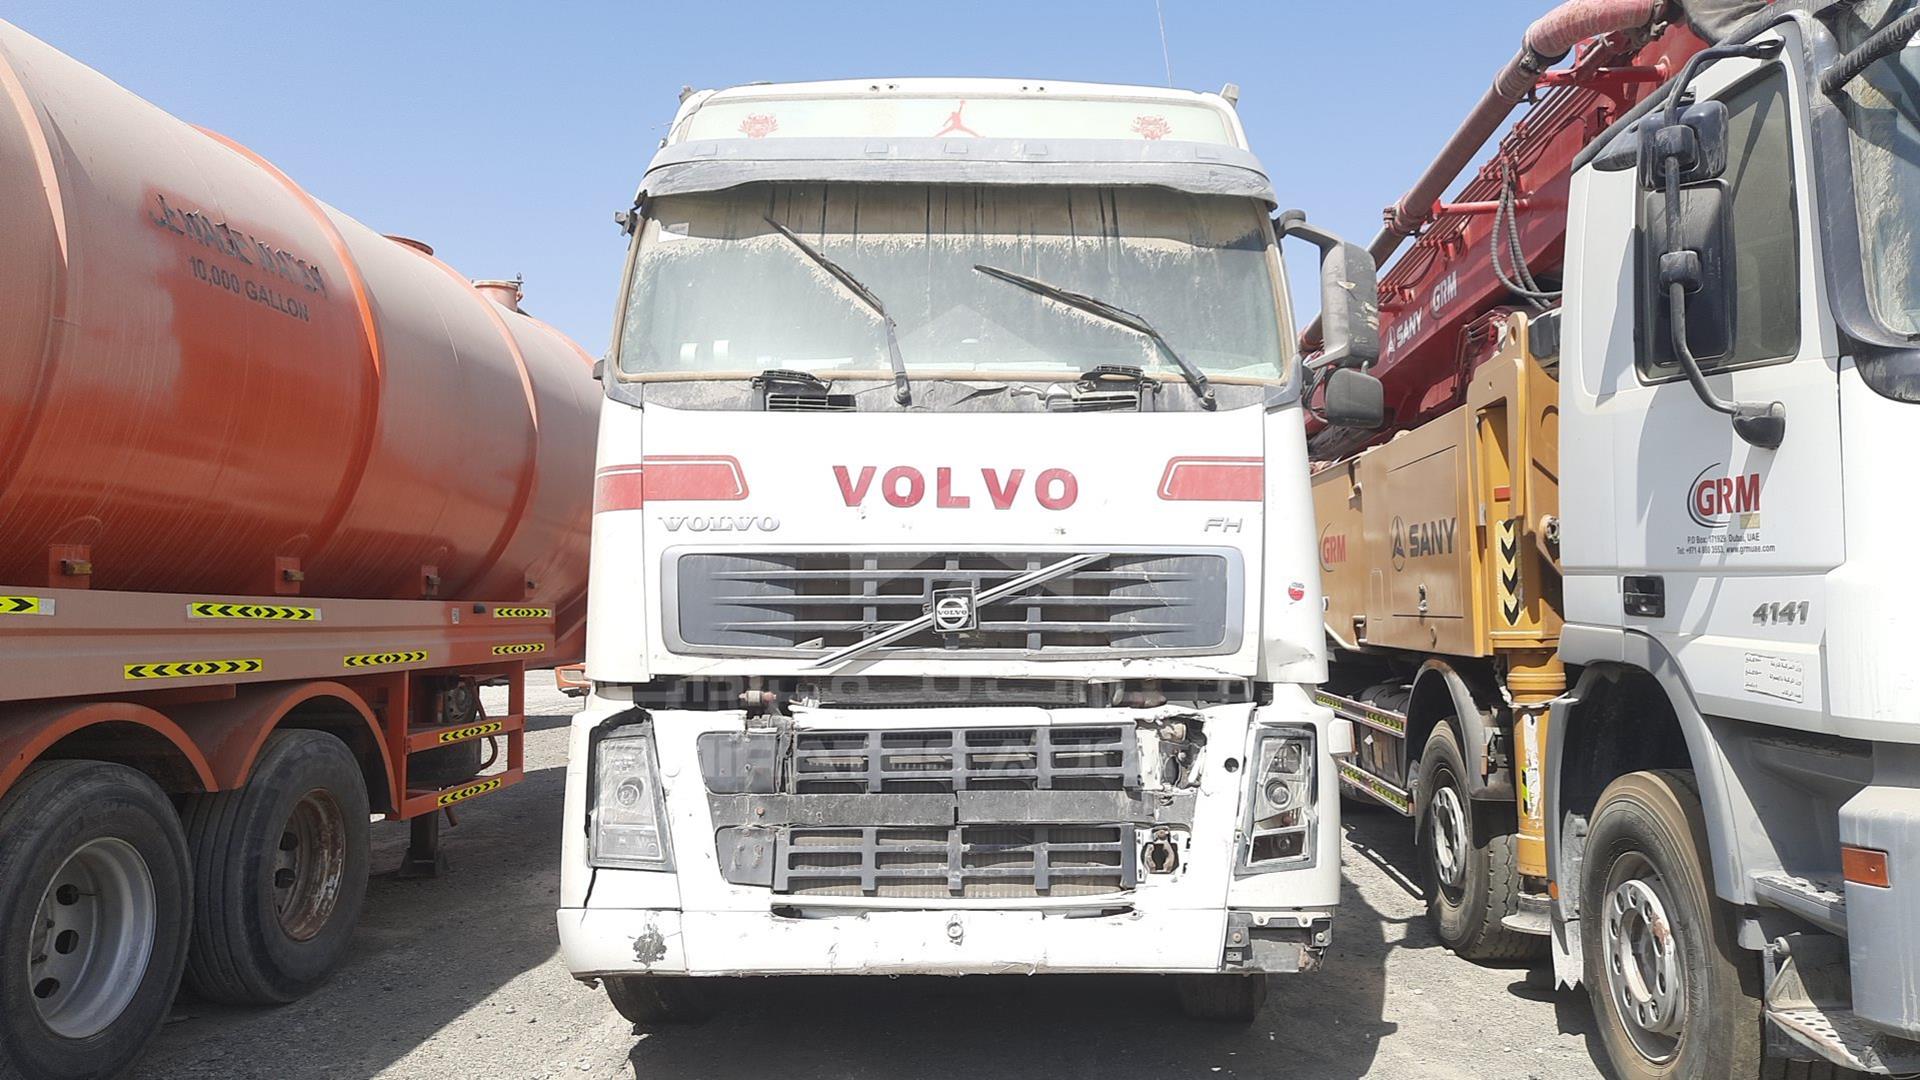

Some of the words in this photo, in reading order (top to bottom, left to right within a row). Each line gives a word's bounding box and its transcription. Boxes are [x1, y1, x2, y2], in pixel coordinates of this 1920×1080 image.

[189, 256, 241, 294] 10,000
[245, 280, 310, 321] GALLON
[1432, 271, 1457, 312] GRM
[1397, 307, 1423, 348] SANY
[832, 465, 1080, 510] VOLVO
[1696, 473, 1760, 516] GRM
[658, 515, 780, 532] VOLVO
[1204, 516, 1244, 533] FH
[1409, 517, 1457, 557] SANY
[1747, 532, 1760, 541] UAE
[1323, 535, 1347, 564] GRM
[1752, 601, 1810, 626] 4141
